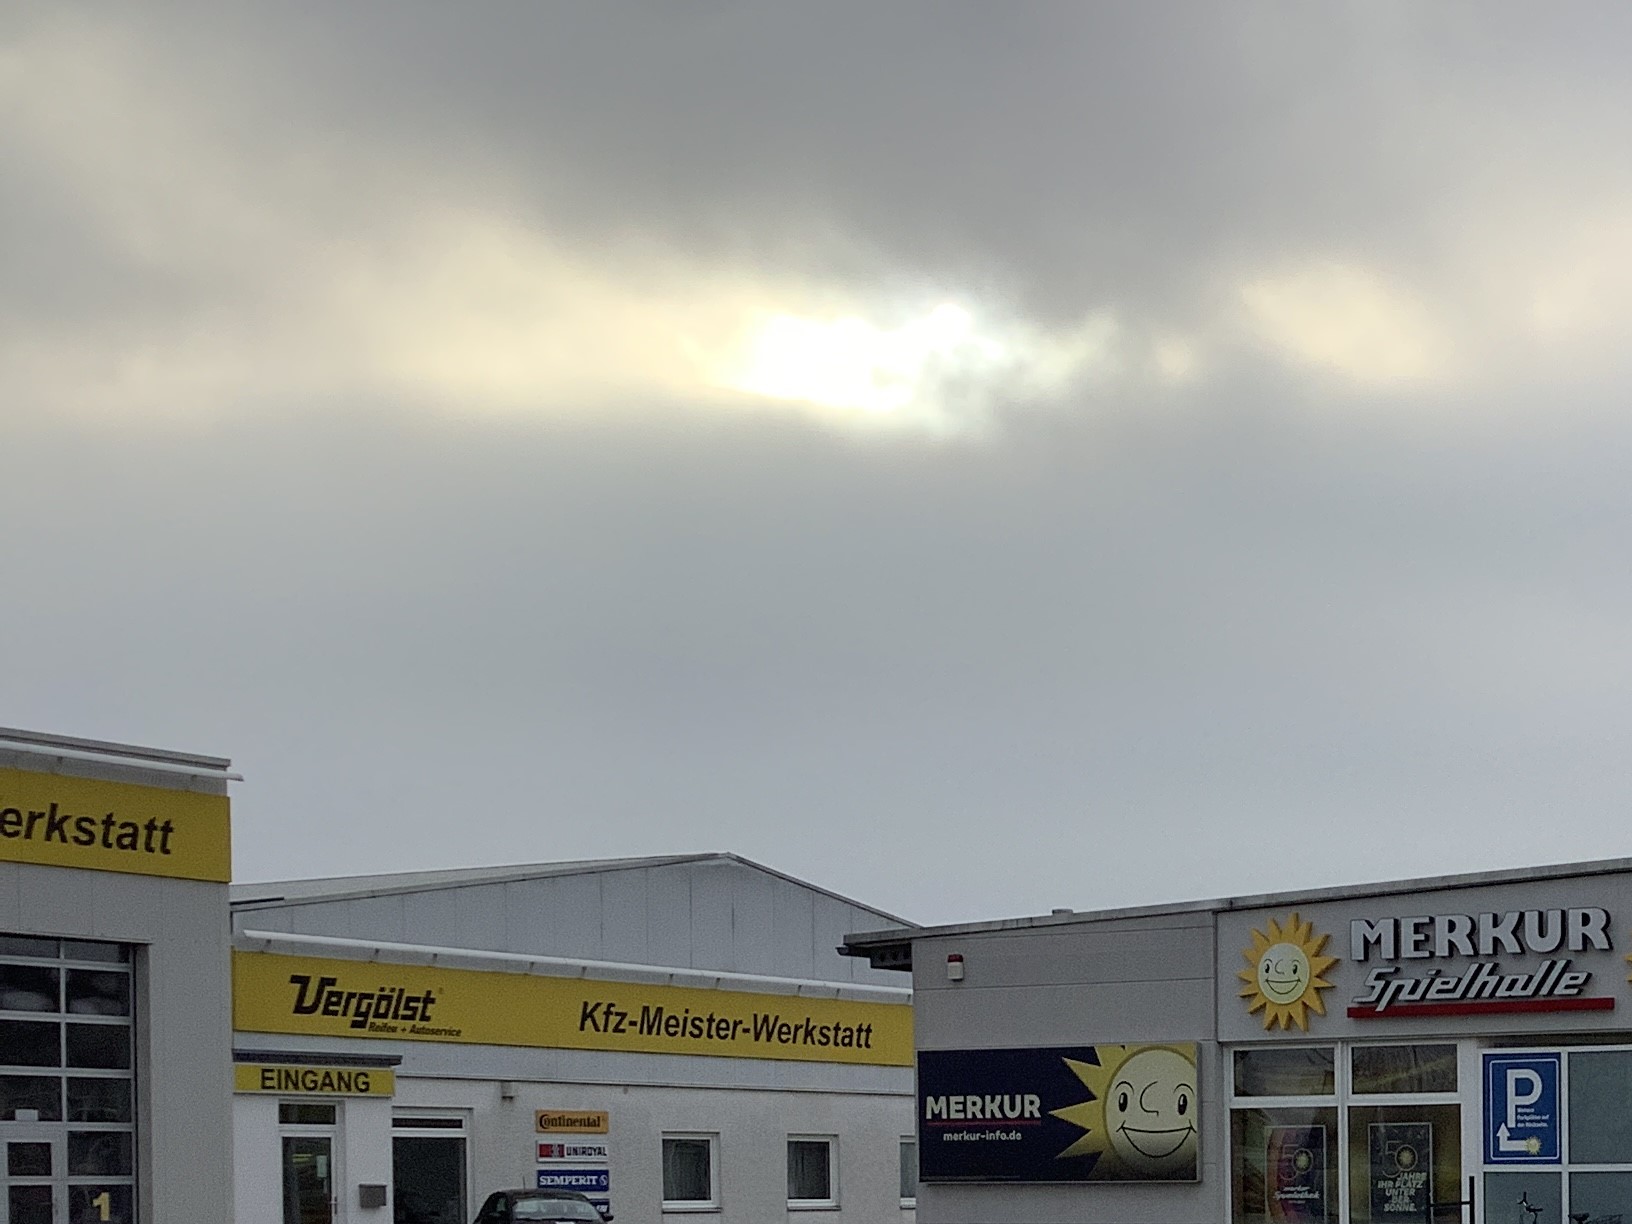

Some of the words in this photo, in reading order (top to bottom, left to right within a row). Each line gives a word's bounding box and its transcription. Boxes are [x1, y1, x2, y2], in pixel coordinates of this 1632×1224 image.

[1350, 907, 1614, 962] MERKUR
[1352, 959, 1592, 1012] Spielhalle
[289, 974, 436, 1029] Vergölst
[368, 1021, 398, 1033] Reifen
[409, 1024, 462, 1037] Autoservice
[579, 1001, 873, 1049] Kfz-Meister-Werkstatt
[261, 1068, 370, 1093] EINGANG
[926, 1094, 1042, 1120] MERKUR
[1507, 1068, 1543, 1128] P
[540, 1114, 601, 1129] Continental
[943, 1130, 1022, 1142] merkur-info.de
[566, 1146, 607, 1157] UNIROYAL
[539, 1175, 598, 1186] SEMPERIT
[92, 1191, 111, 1221] 1
